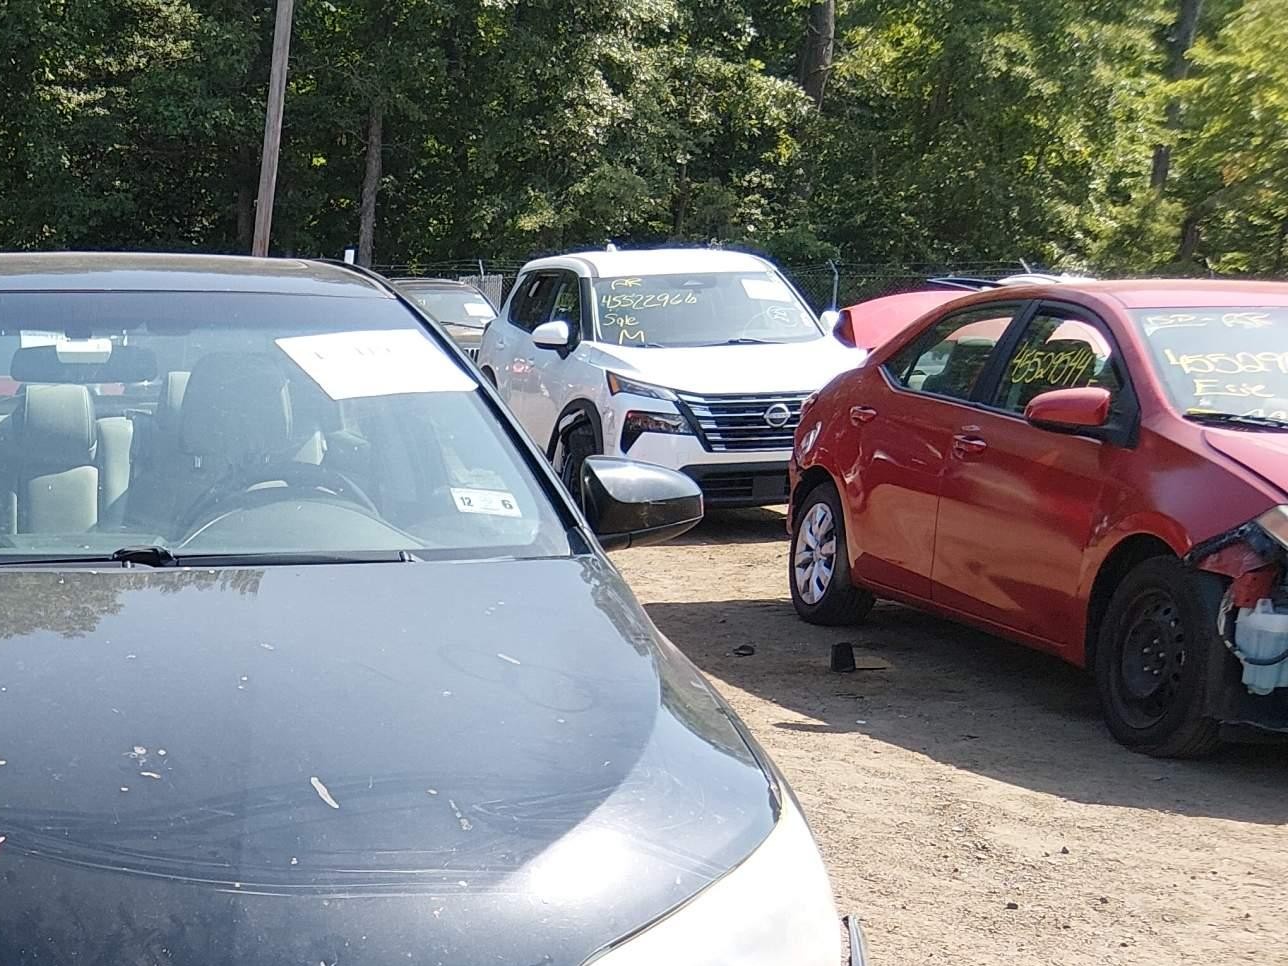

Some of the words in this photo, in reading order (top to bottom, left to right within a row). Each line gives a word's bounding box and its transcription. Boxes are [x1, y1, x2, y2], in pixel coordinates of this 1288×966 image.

[601, 292, 697, 309] 45522966
[460, 496, 474, 507] 12
[501, 499, 514, 510] 6
